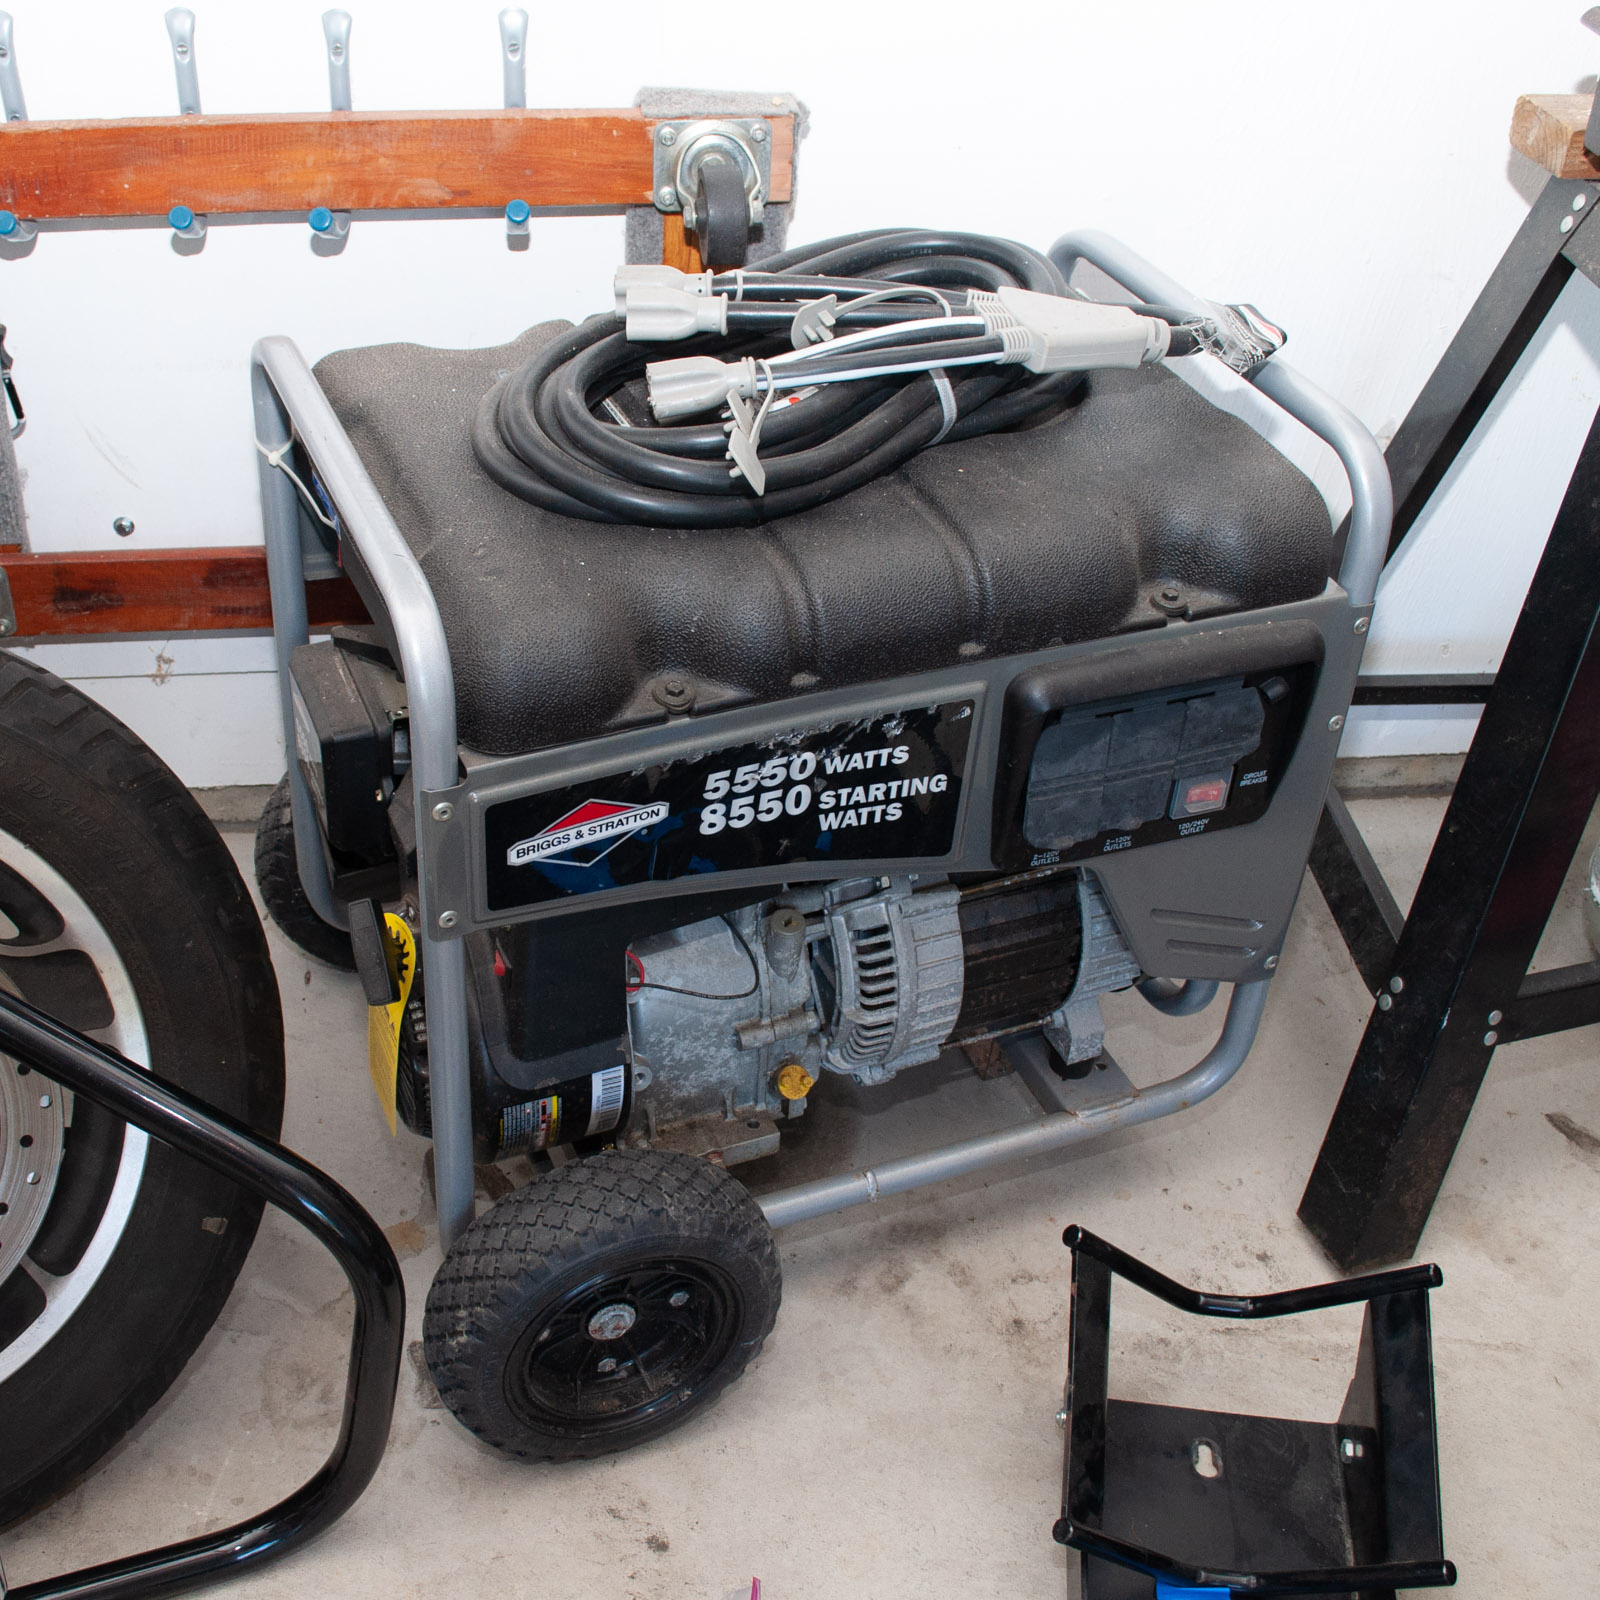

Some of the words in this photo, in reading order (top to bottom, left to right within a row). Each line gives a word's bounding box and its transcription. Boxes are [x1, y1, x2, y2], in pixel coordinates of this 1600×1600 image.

[702, 751, 817, 800] 5550
[824, 745, 910, 775] WATTS
[1243, 770, 1268, 780] CIRCUIT
[1240, 776, 1268, 787] BREAKER
[699, 784, 812, 835] 8550
[818, 774, 948, 810] STARTING
[818, 803, 903, 832] WATTS
[1179, 818, 1210, 830] 120/240V
[516, 834, 571, 858] BRIGGS
[574, 830, 585, 840] &
[588, 808, 661, 836] STRATTON
[1180, 825, 1204, 836] OUTLET
[1103, 841, 1132, 852] OUTLETS
[1030, 856, 1060, 867] OUTLETS
